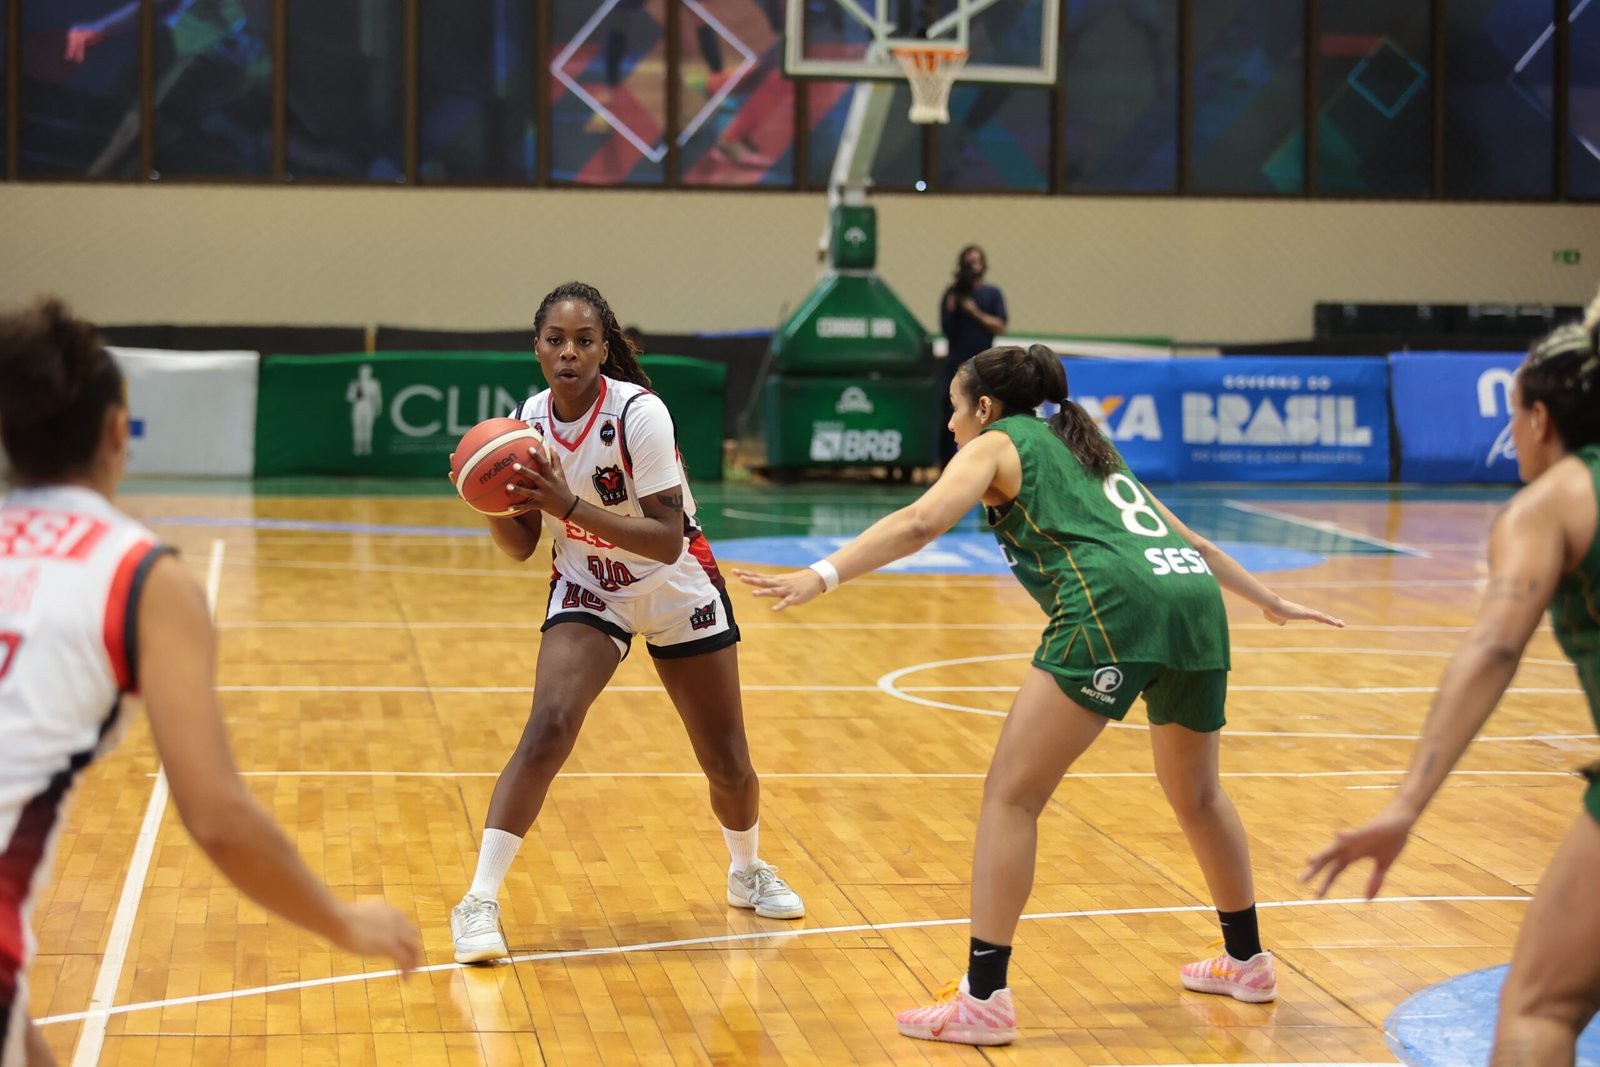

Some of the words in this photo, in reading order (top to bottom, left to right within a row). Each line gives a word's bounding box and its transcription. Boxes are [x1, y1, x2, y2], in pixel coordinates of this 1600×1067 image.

[1222, 374, 1302, 391] GOVERNO
[1306, 375, 1333, 391] DO
[1182, 391, 1373, 447] BRASIL
[842, 429, 903, 461] BRB
[479, 453, 518, 485] molten
[602, 489, 625, 501] SESI
[1102, 472, 1169, 538] 8
[692, 612, 715, 625] SESI
[1080, 685, 1116, 705] MUTUM
